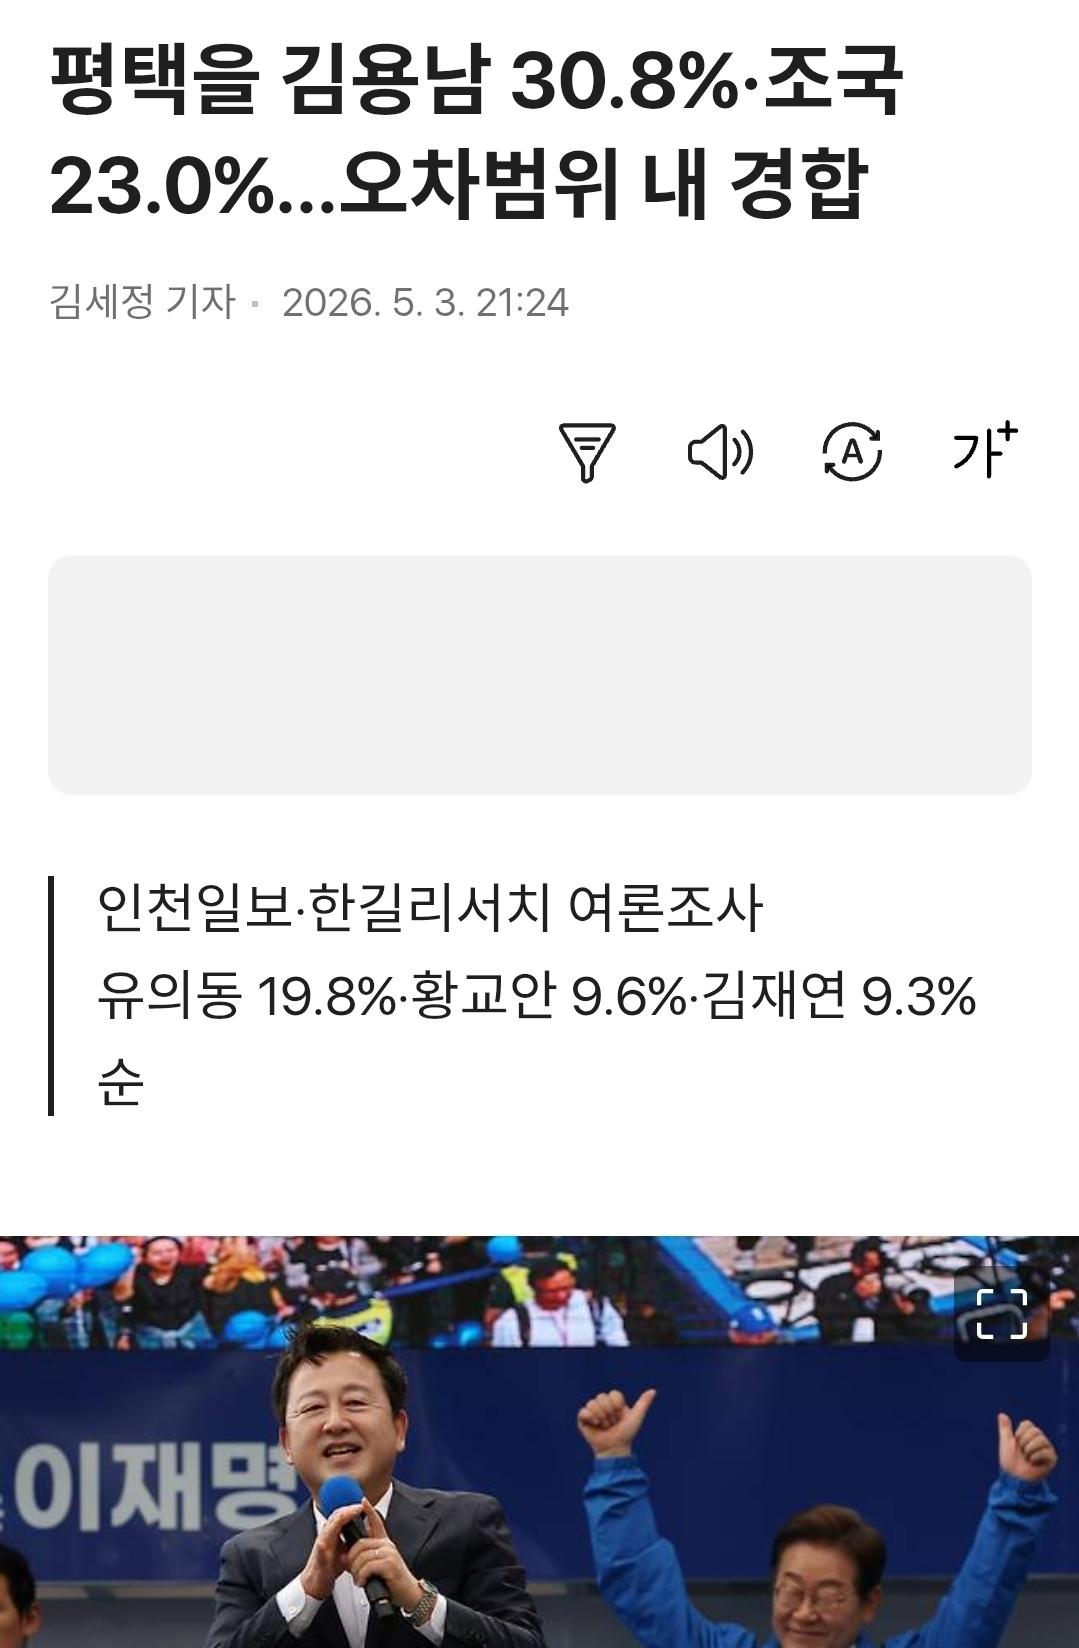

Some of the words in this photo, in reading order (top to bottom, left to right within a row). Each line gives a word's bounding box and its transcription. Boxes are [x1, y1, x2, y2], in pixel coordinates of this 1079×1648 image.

[51, 42, 259, 115] 평택을
[282, 42, 491, 115] 김용남
[512, 45, 903, 115] 30.8%·조국
[645, 147, 705, 220] 내
[731, 147, 869, 219] 경합
[50, 283, 151, 319] 김세정
[167, 283, 236, 319] 기자
[284, 288, 380, 316] 2026.
[394, 288, 422, 316] 5.
[435, 288, 463, 316] 3.
[477, 288, 569, 316] 21:24
[99, 883, 548, 932] 인천일보·한길리서치
[570, 883, 763, 932] 여론조사
[98, 970, 242, 1019] 유의동
[259, 970, 557, 1019] 19.8%·황교안
[573, 970, 844, 1019] 9.6%·김재연
[863, 976, 976, 1016] 9.3%
[98, 1058, 143, 1106] 순
[14, 1441, 300, 1533] 이재명
